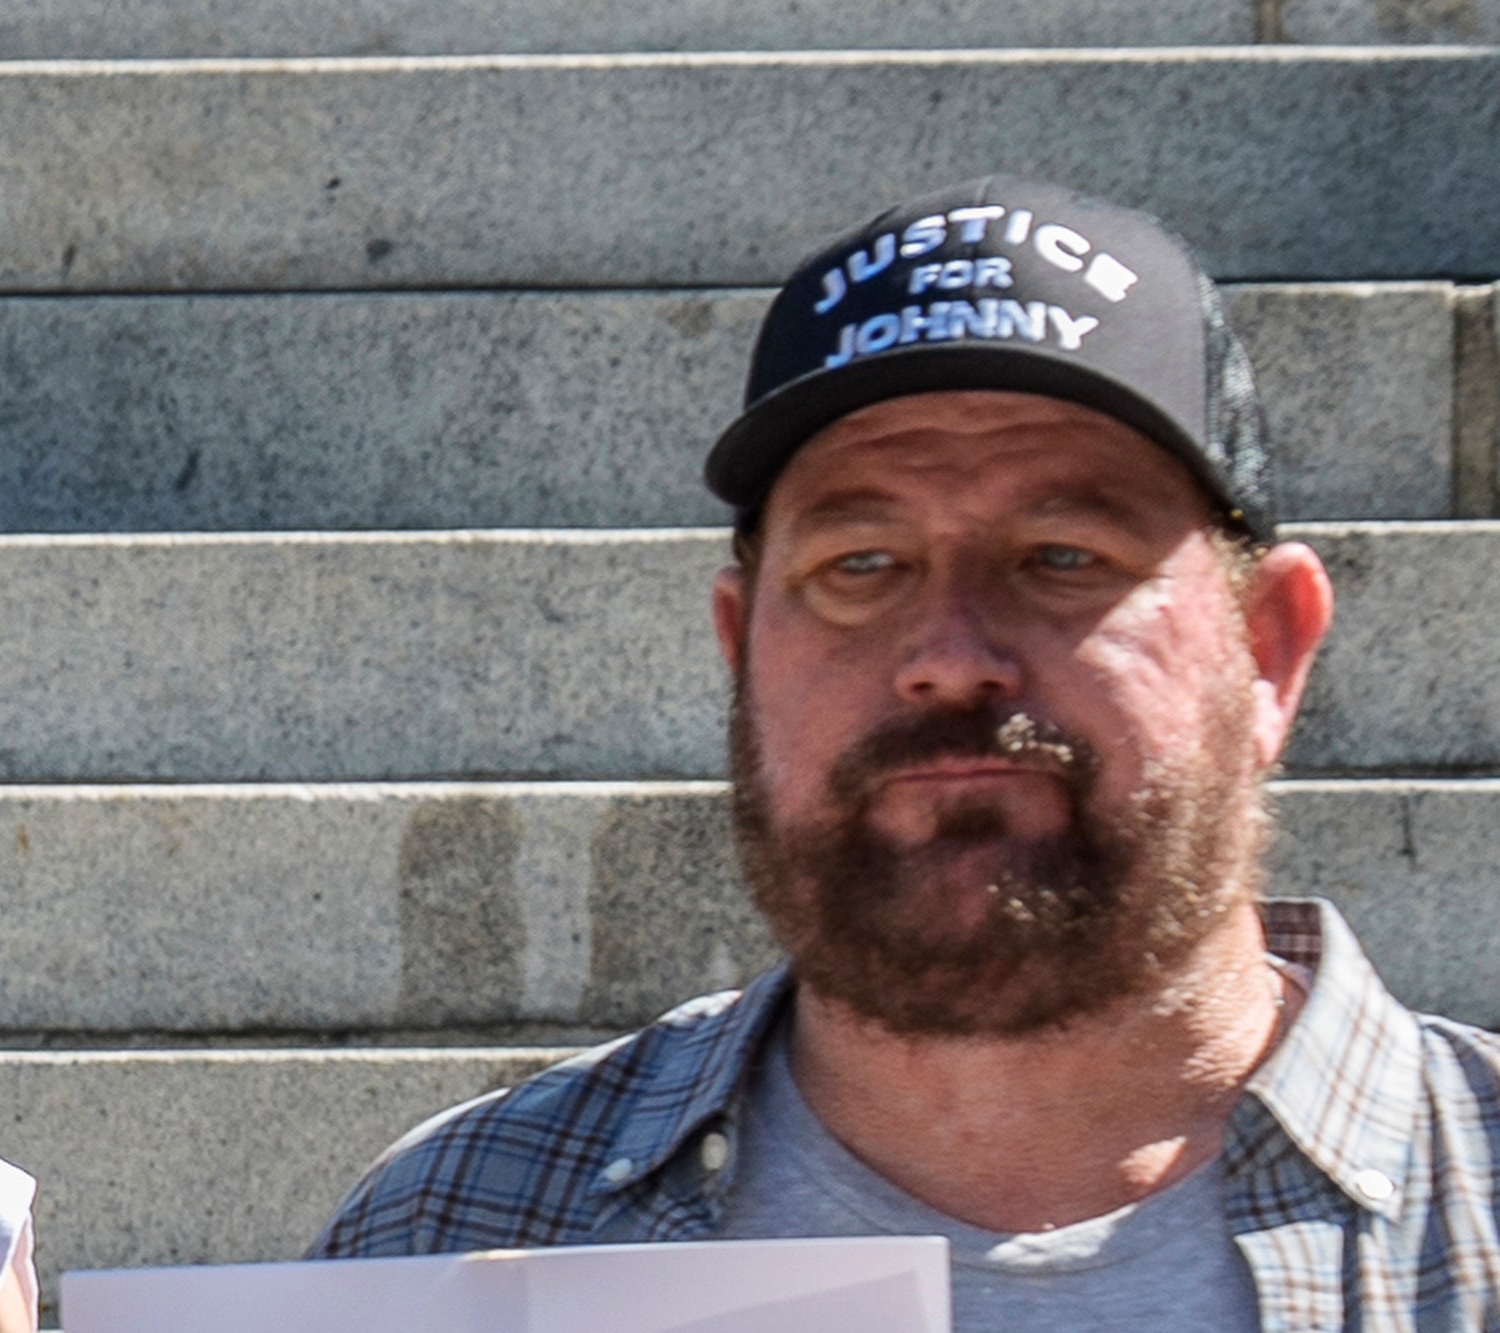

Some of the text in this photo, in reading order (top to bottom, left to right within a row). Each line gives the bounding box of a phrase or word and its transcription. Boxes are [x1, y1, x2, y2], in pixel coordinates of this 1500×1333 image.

[814, 206, 1137, 313] JUSTICE
[909, 257, 1013, 294] FOR
[825, 299, 1098, 369] JOHNNY
